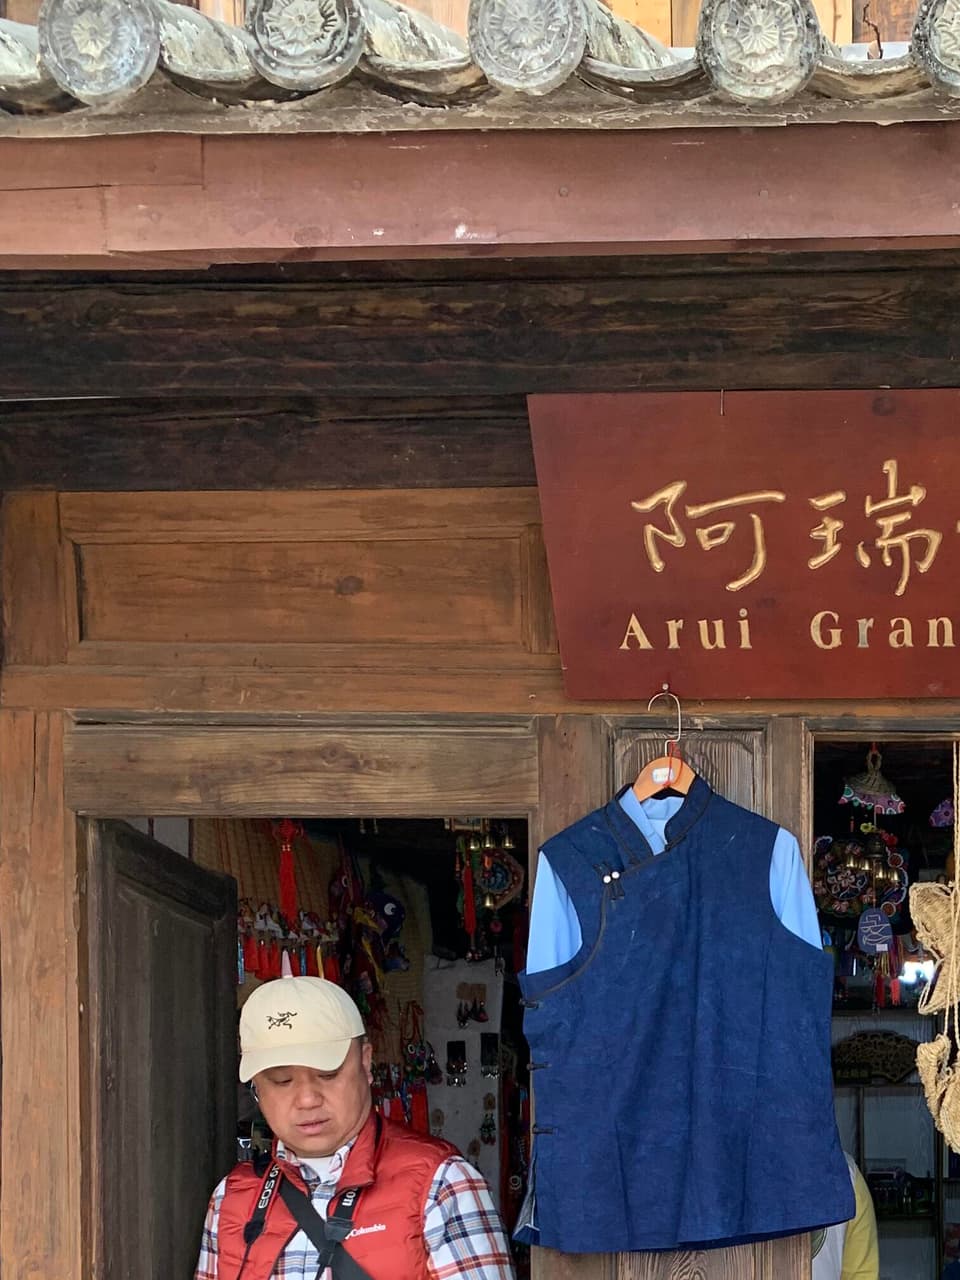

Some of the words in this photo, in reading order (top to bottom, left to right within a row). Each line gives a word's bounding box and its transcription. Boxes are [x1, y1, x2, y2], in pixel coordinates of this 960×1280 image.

[618, 608, 753, 649] Arui
[258, 1180, 274, 1209] EOS
[351, 1224, 386, 1237] Columbia
